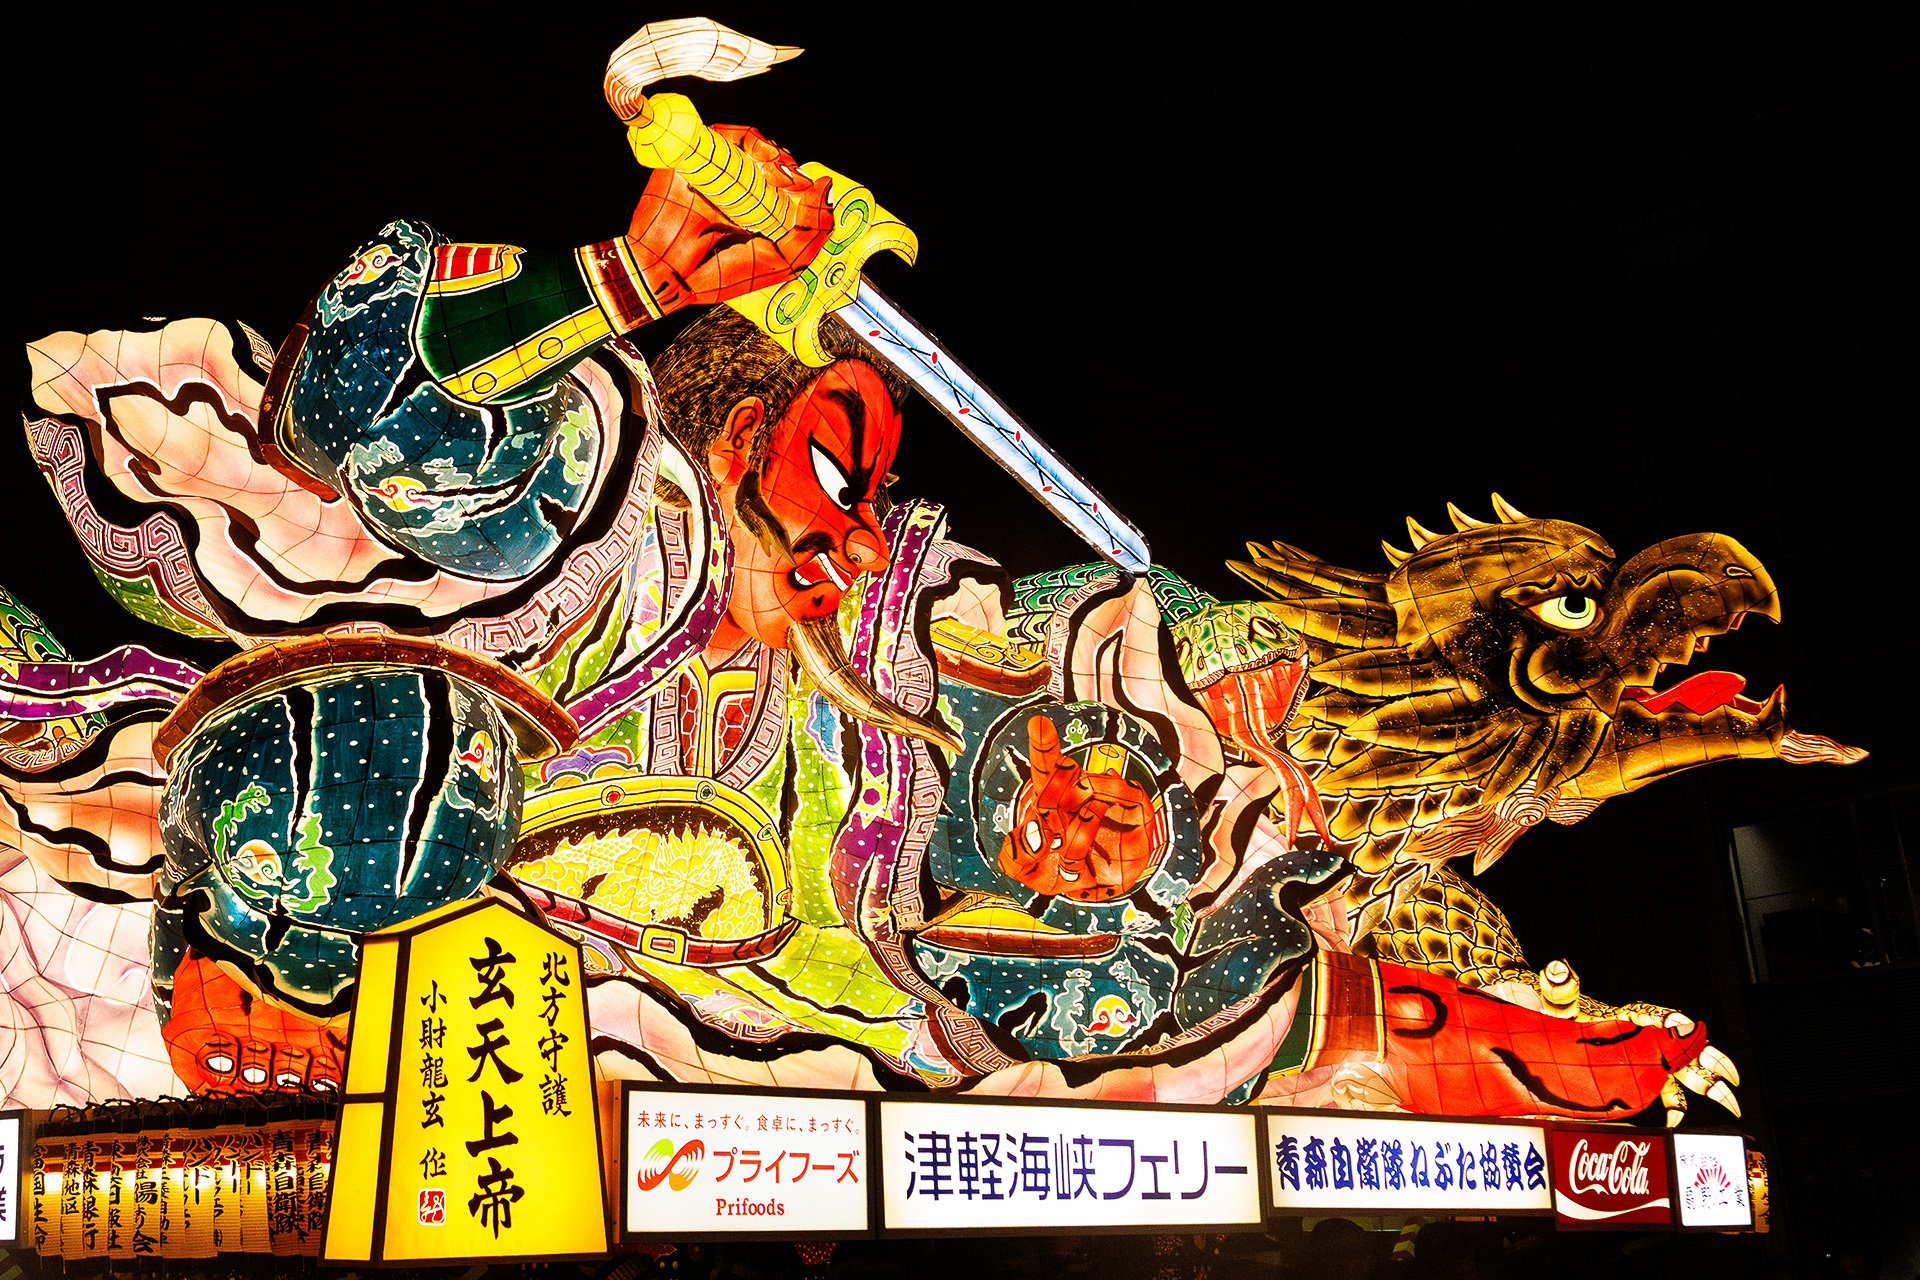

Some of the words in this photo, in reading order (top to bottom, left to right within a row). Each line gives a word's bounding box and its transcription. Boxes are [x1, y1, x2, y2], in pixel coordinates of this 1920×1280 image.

[419, 979, 449, 1129] 小財龍玄
[538, 951, 572, 1118] 北方守護
[465, 937, 525, 1240] 玄天上帝
[270, 1129, 297, 1235] 青森自衛隊
[713, 1146, 860, 1184] プライフーズ
[903, 1130, 1248, 1201] 津軽海峡フェリー
[1275, 1134, 1547, 1191] 青森自衛隊ねぶた協賛会
[1569, 1138, 1651, 1196] Coca-Cola
[716, 1198, 785, 1216] Prifoods
